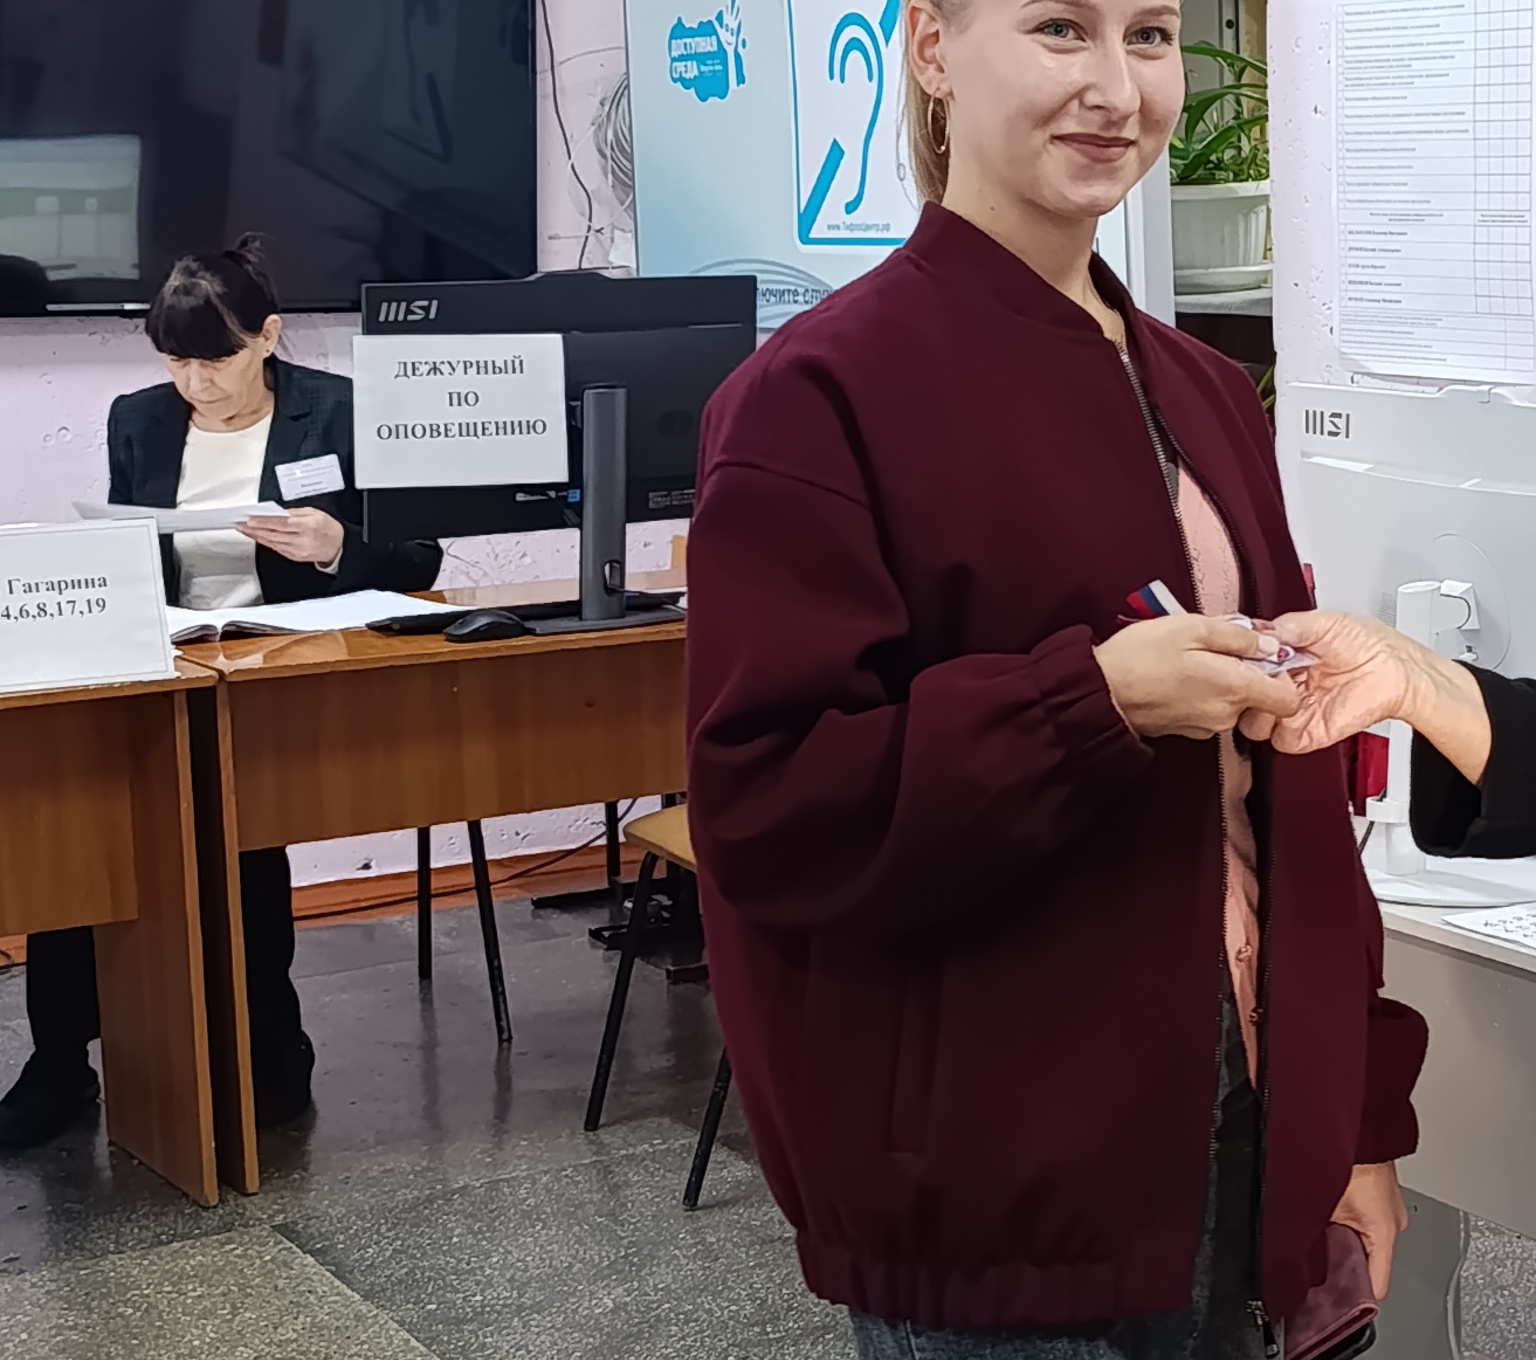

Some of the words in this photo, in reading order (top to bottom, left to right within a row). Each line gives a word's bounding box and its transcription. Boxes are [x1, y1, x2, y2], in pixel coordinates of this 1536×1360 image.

[671, 35, 718, 58] ДОСТУПНАЯ
[672, 60, 699, 79] СРЕДА
[757, 287, 800, 304] ючите
[394, 354, 525, 380] ДЕЖУРНЫЙ
[447, 390, 480, 407] ПО
[376, 418, 547, 440] ОПОВЕЩЕНИЮ
[7, 576, 108, 596] Гагарина
[0, 597, 107, 622] 4,6,8,17,19
